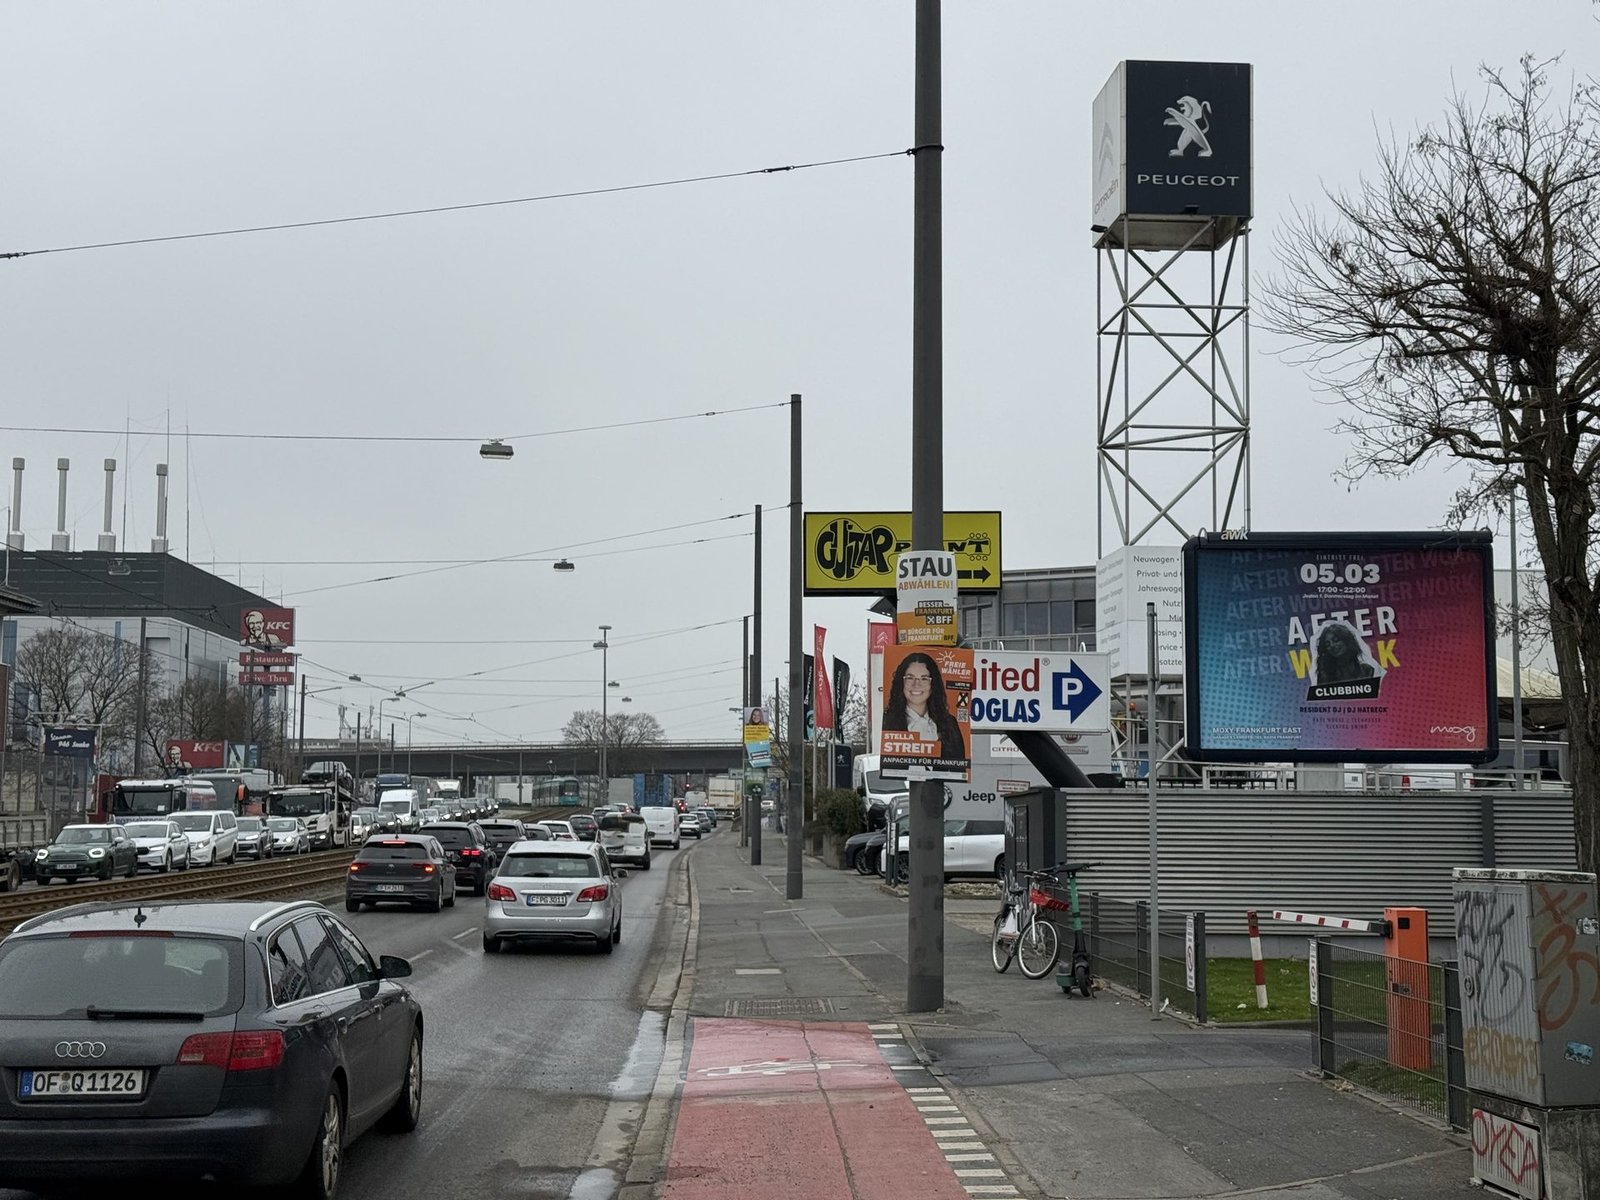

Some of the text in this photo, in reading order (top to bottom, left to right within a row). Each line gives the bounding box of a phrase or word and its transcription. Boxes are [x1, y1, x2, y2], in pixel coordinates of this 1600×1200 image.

[1137, 173, 1240, 187] PEUGEOT
[1220, 527, 1249, 541] awk
[894, 540, 990, 553] PNT
[899, 556, 952, 579] STAU
[1300, 563, 1381, 584] 05.03
[898, 578, 954, 591] ABWÄHLEN!
[266, 621, 291, 630] KFC
[936, 615, 952, 624] BFF
[1287, 605, 1398, 646] AFTER
[944, 661, 967, 669] FREIE
[1288, 638, 1401, 680] WK
[268, 674, 288, 682] Thru
[941, 667, 971, 677] WÄHLER
[1061, 677, 1084, 706] P
[1315, 684, 1372, 697] CLUBBING
[884, 732, 914, 741] STELLA
[193, 742, 222, 752] KFC
[884, 742, 935, 755] STREIT
[882, 757, 969, 767] ANPACKEN FÜR FRANKFURT
[963, 789, 996, 804] Jeep
[34, 1073, 59, 1093] OF
